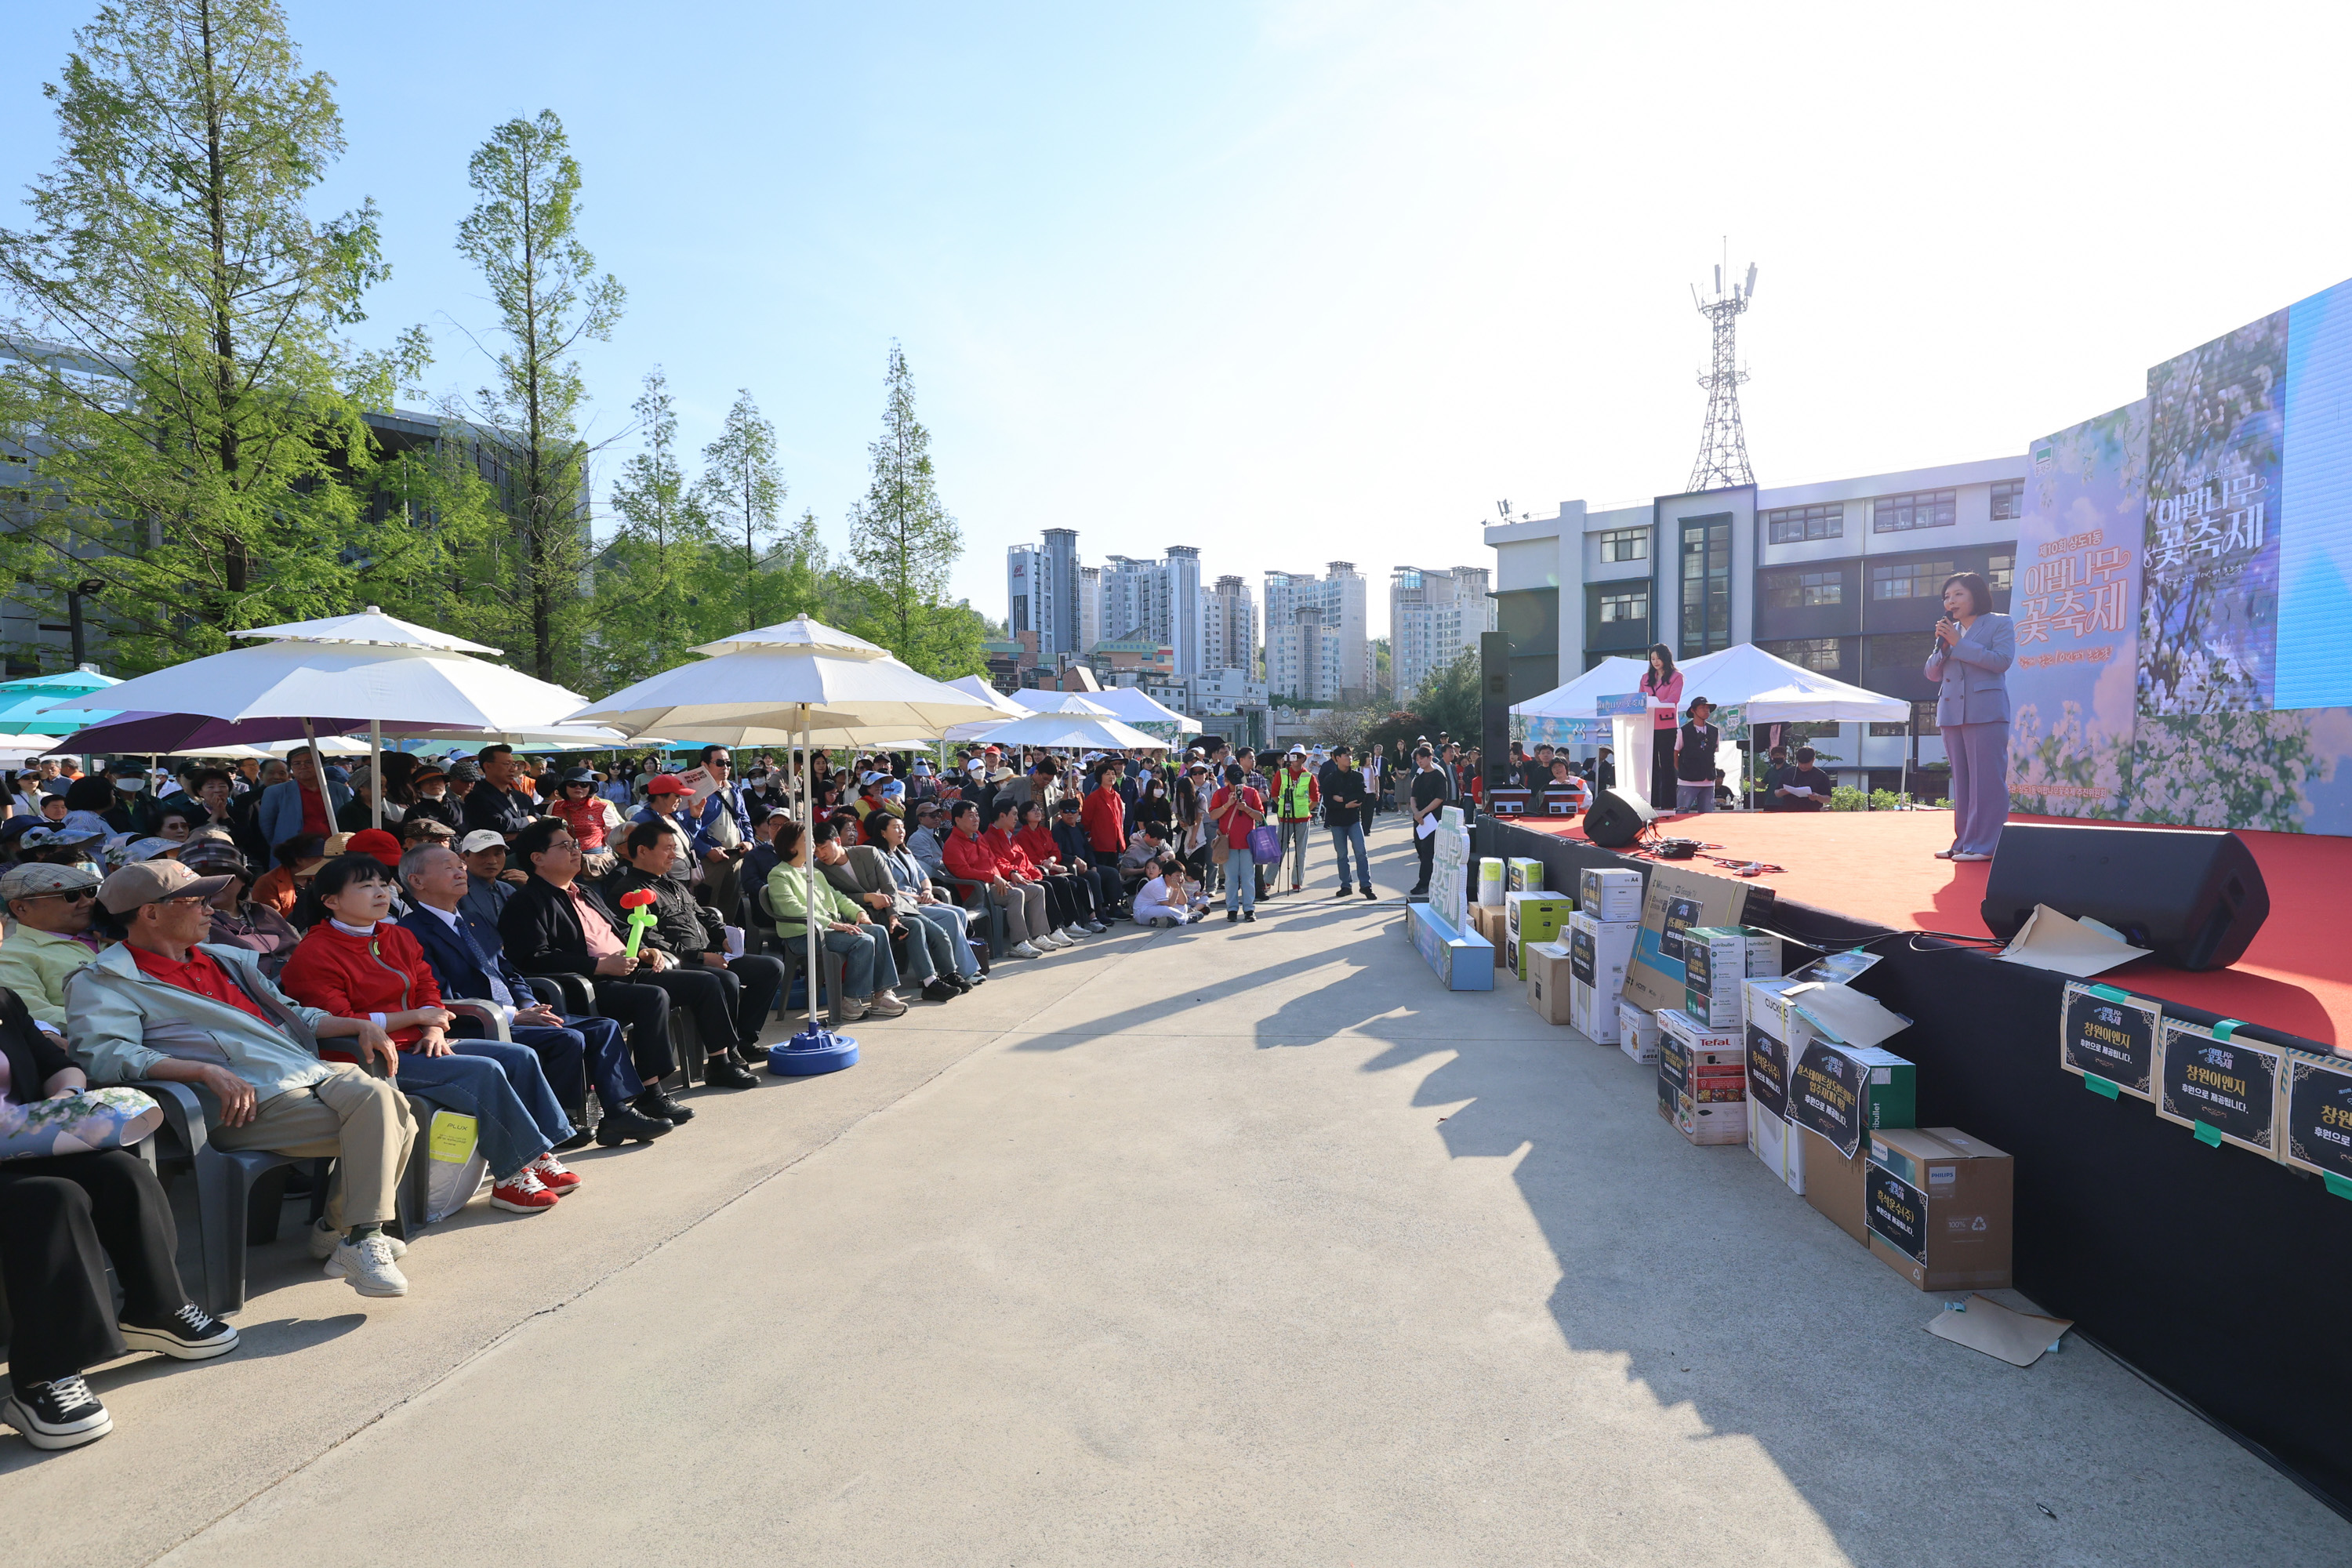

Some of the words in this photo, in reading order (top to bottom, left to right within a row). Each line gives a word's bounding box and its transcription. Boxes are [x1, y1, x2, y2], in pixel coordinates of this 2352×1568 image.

[2034, 463, 2051, 477] 동작구
[2159, 474, 2267, 524] 이팝나무
[2039, 539, 2067, 557] 제10회
[2069, 530, 2103, 550] 상도1동
[2144, 502, 2264, 571] 꽃축제
[2024, 547, 2132, 596] 이팝나무
[2014, 580, 2127, 645] 꽃축제
[2077, 787, 2107, 798] 추진위원회
[1658, 1017, 1669, 1029] Tefal
[2084, 1022, 2131, 1049] 창원이엔지
[1752, 1050, 1780, 1080] 흑석운수(주)
[2080, 1039, 2101, 1052] 후원으로
[2102, 1046, 2132, 1065] 제공됩니다.
[2205, 1054, 2233, 1070] 꽃축제
[2186, 1064, 2246, 1097] 창원이엔지
[1805, 1094, 1825, 1112] 후원으로
[1826, 1105, 1848, 1128] 제공됩니다.
[2182, 1083, 2209, 1100] 후원으로
[2210, 1092, 2249, 1114] 제공됩니다.
[1873, 1145, 1886, 1157] PHILIPS
[2314, 1127, 2350, 1147] 후원으로
[1875, 1205, 1892, 1221] 후원으로
[1892, 1215, 1915, 1237] 제공됩니다.
[1877, 1189, 1915, 1223] 흑석운수(주)
